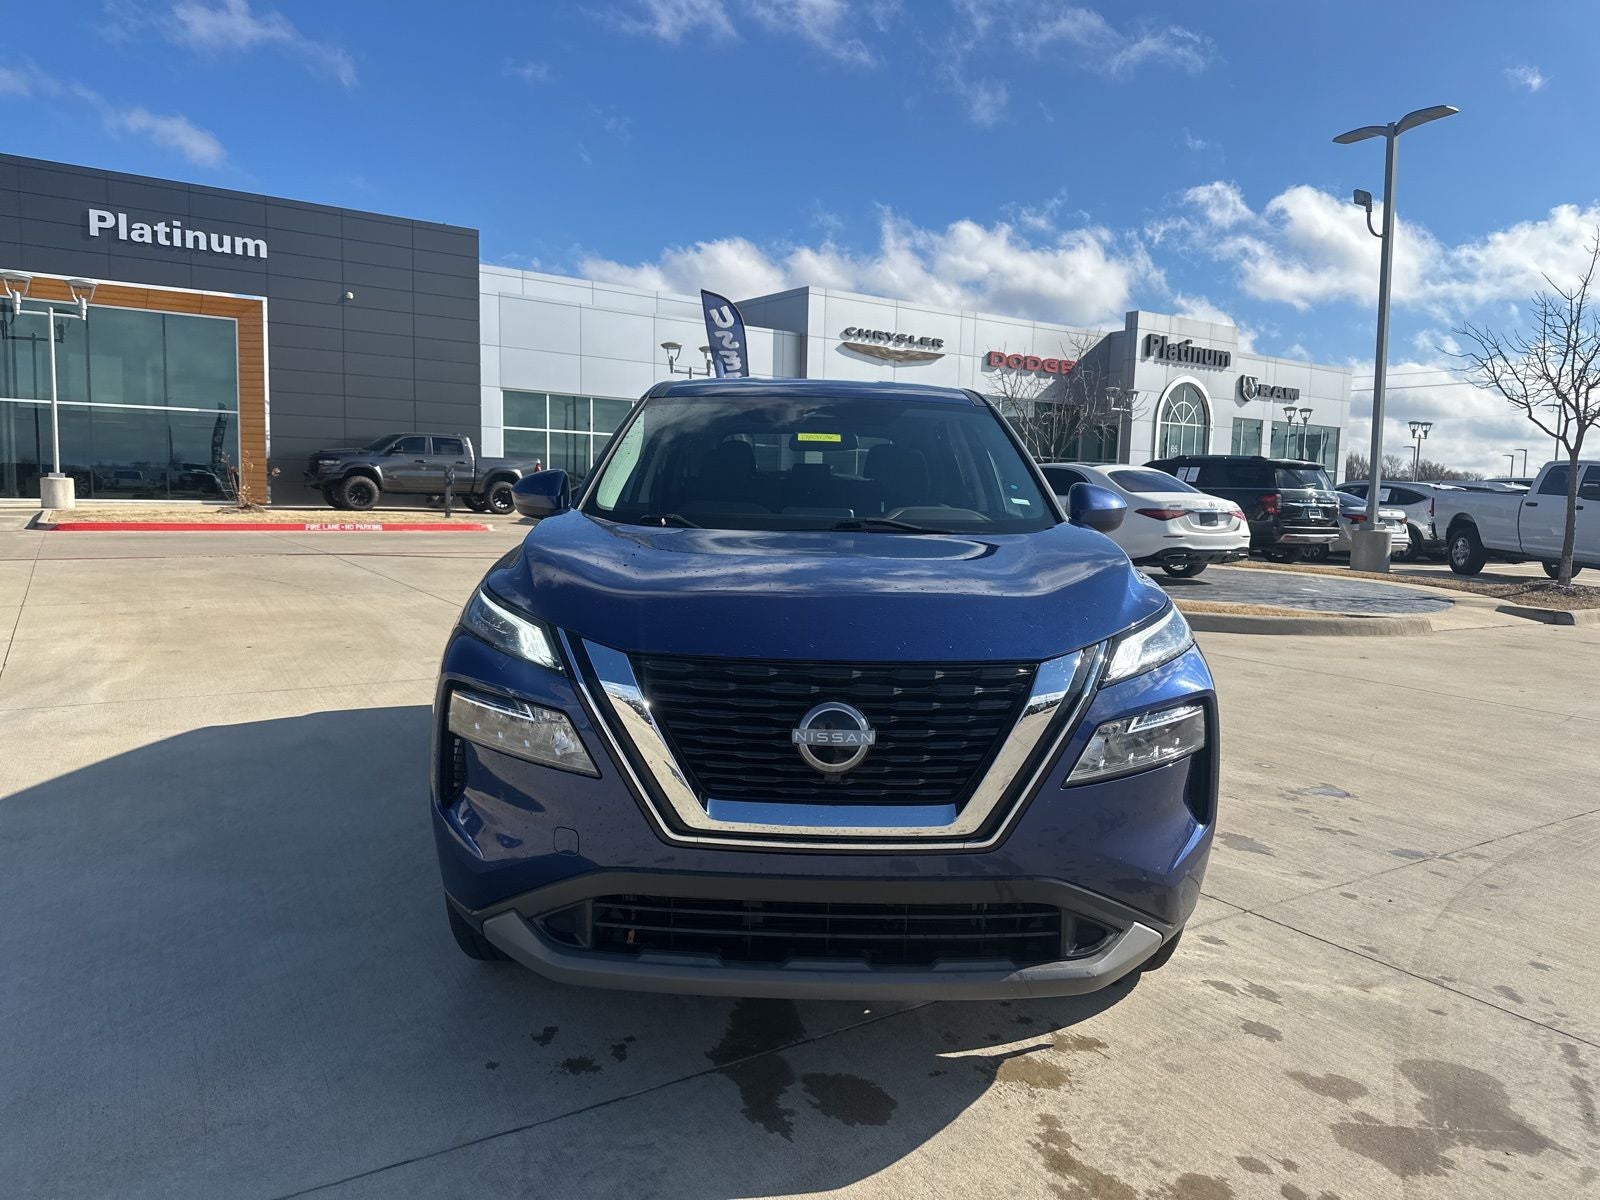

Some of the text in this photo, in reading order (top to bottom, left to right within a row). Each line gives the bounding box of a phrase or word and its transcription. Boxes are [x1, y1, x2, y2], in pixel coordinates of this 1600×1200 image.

[88, 208, 268, 259] Platinum
[843, 326, 944, 349] CHRYSLER
[1147, 333, 1232, 367] Platinum
[987, 351, 1076, 375] DODGE
[1259, 383, 1301, 401] RAM
[305, 523, 383, 531] FIRE LANE NO PARKING
[795, 730, 873, 743] NISSAN
